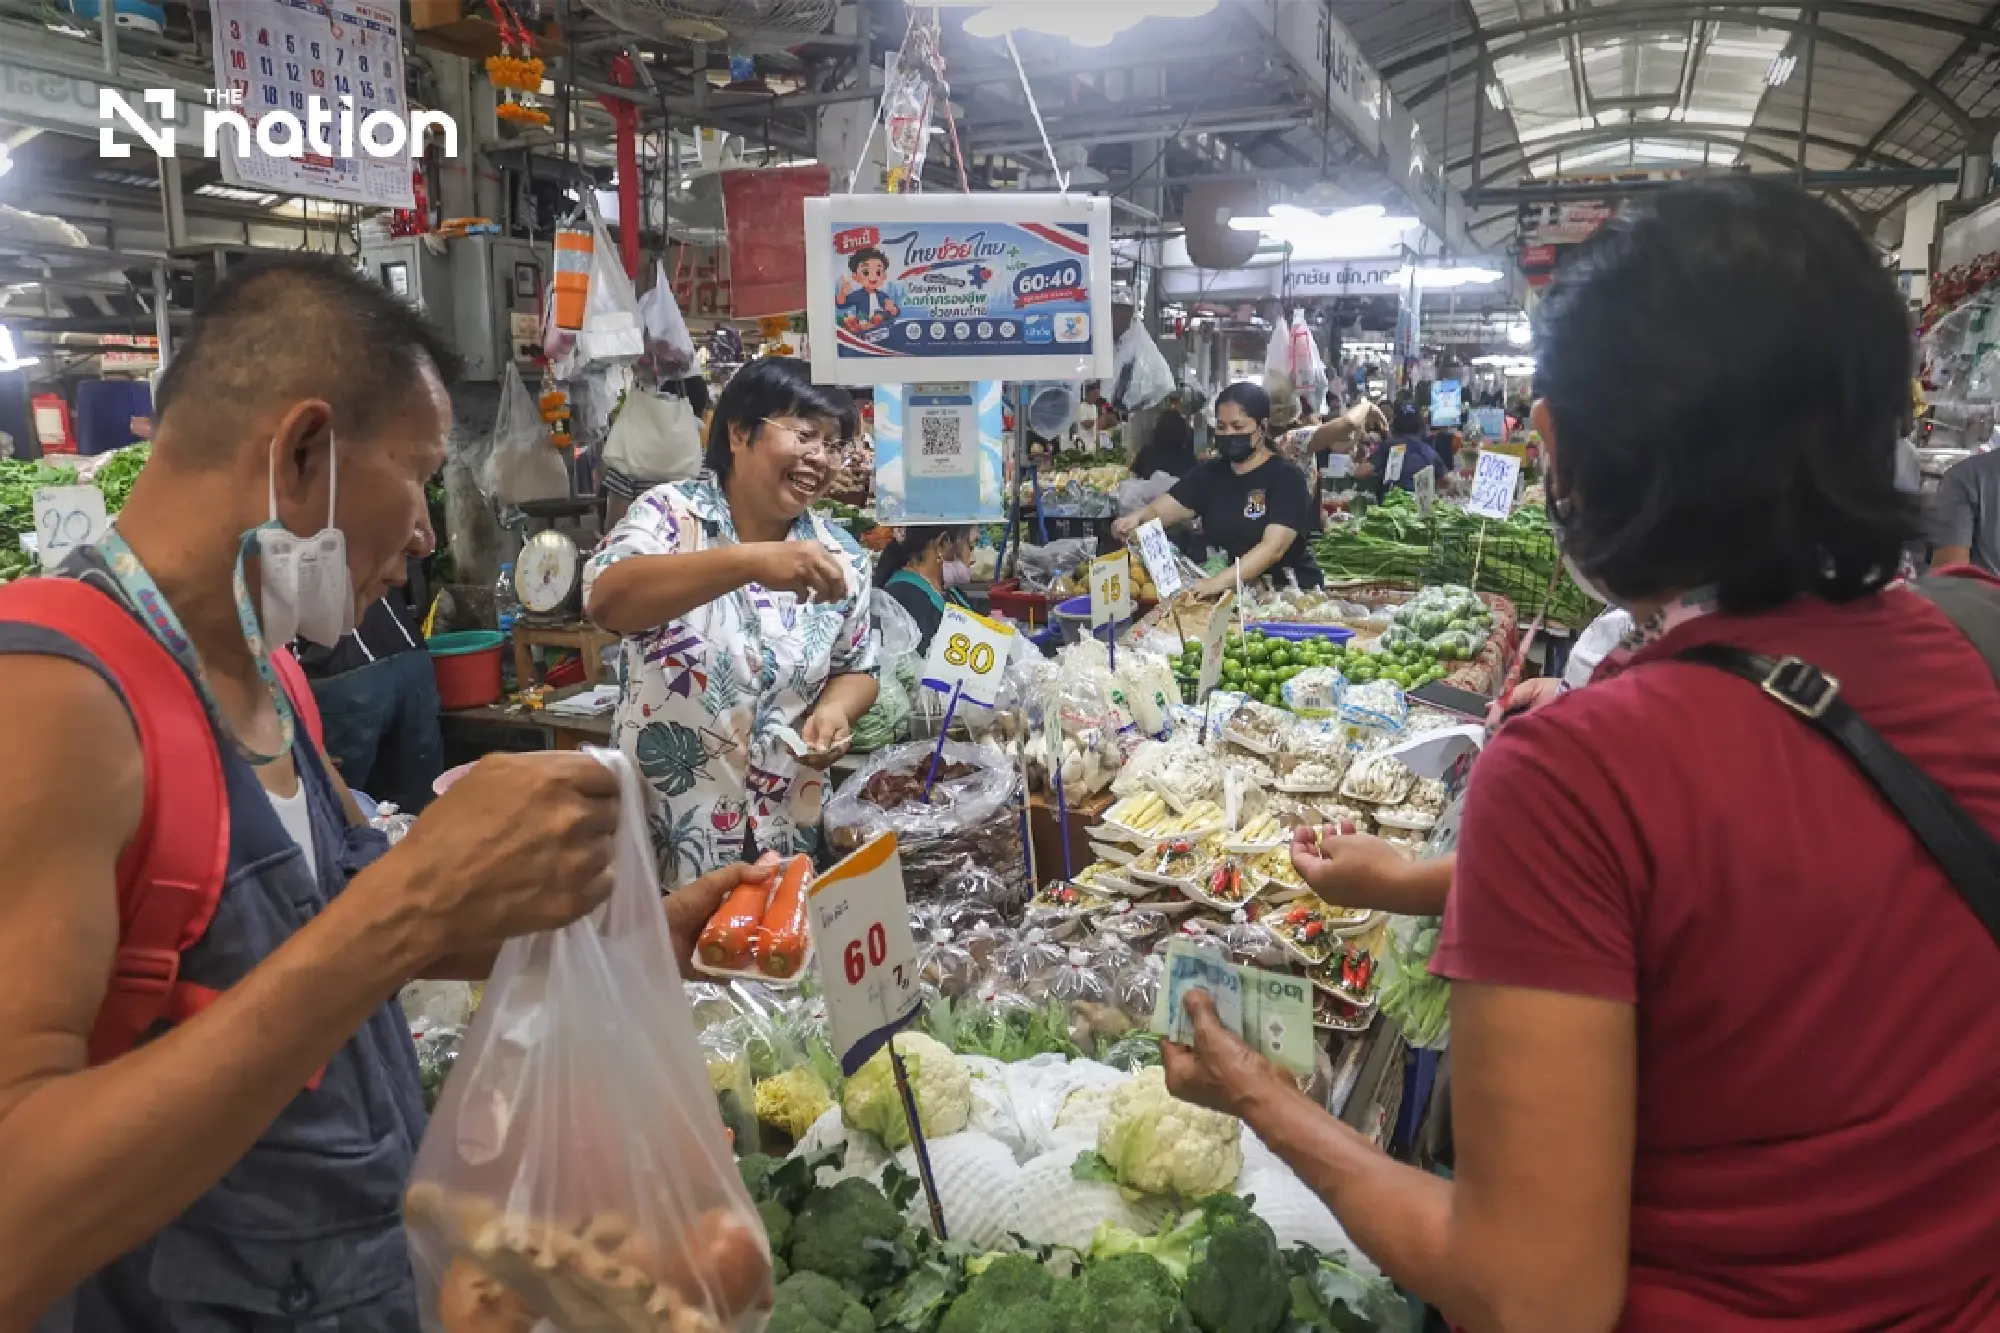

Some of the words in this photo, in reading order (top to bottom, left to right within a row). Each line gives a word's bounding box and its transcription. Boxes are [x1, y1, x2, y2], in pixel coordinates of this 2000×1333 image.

[230, 20, 241, 40] 3
[257, 28, 269, 47] 4
[285, 35, 295, 54] 5
[311, 42, 320, 59] 6
[337, 48, 344, 66] 7
[359, 55, 369, 73] 8
[230, 50, 247, 70] 10
[260, 56, 273, 76] 11
[286, 63, 300, 81] 12
[311, 69, 324, 88] 13
[334, 74, 349, 94] 14
[360, 80, 374, 99] 15
[262, 85, 278, 104] 18
[289, 90, 303, 109] 19
[881, 230, 1006, 266] ไทยช่วยไทย
[1020, 267, 1077, 293] 60:40
[43, 509, 91, 548] 20
[1101, 573, 1121, 605] 15
[944, 633, 994, 674] 80
[844, 922, 886, 986] 60
